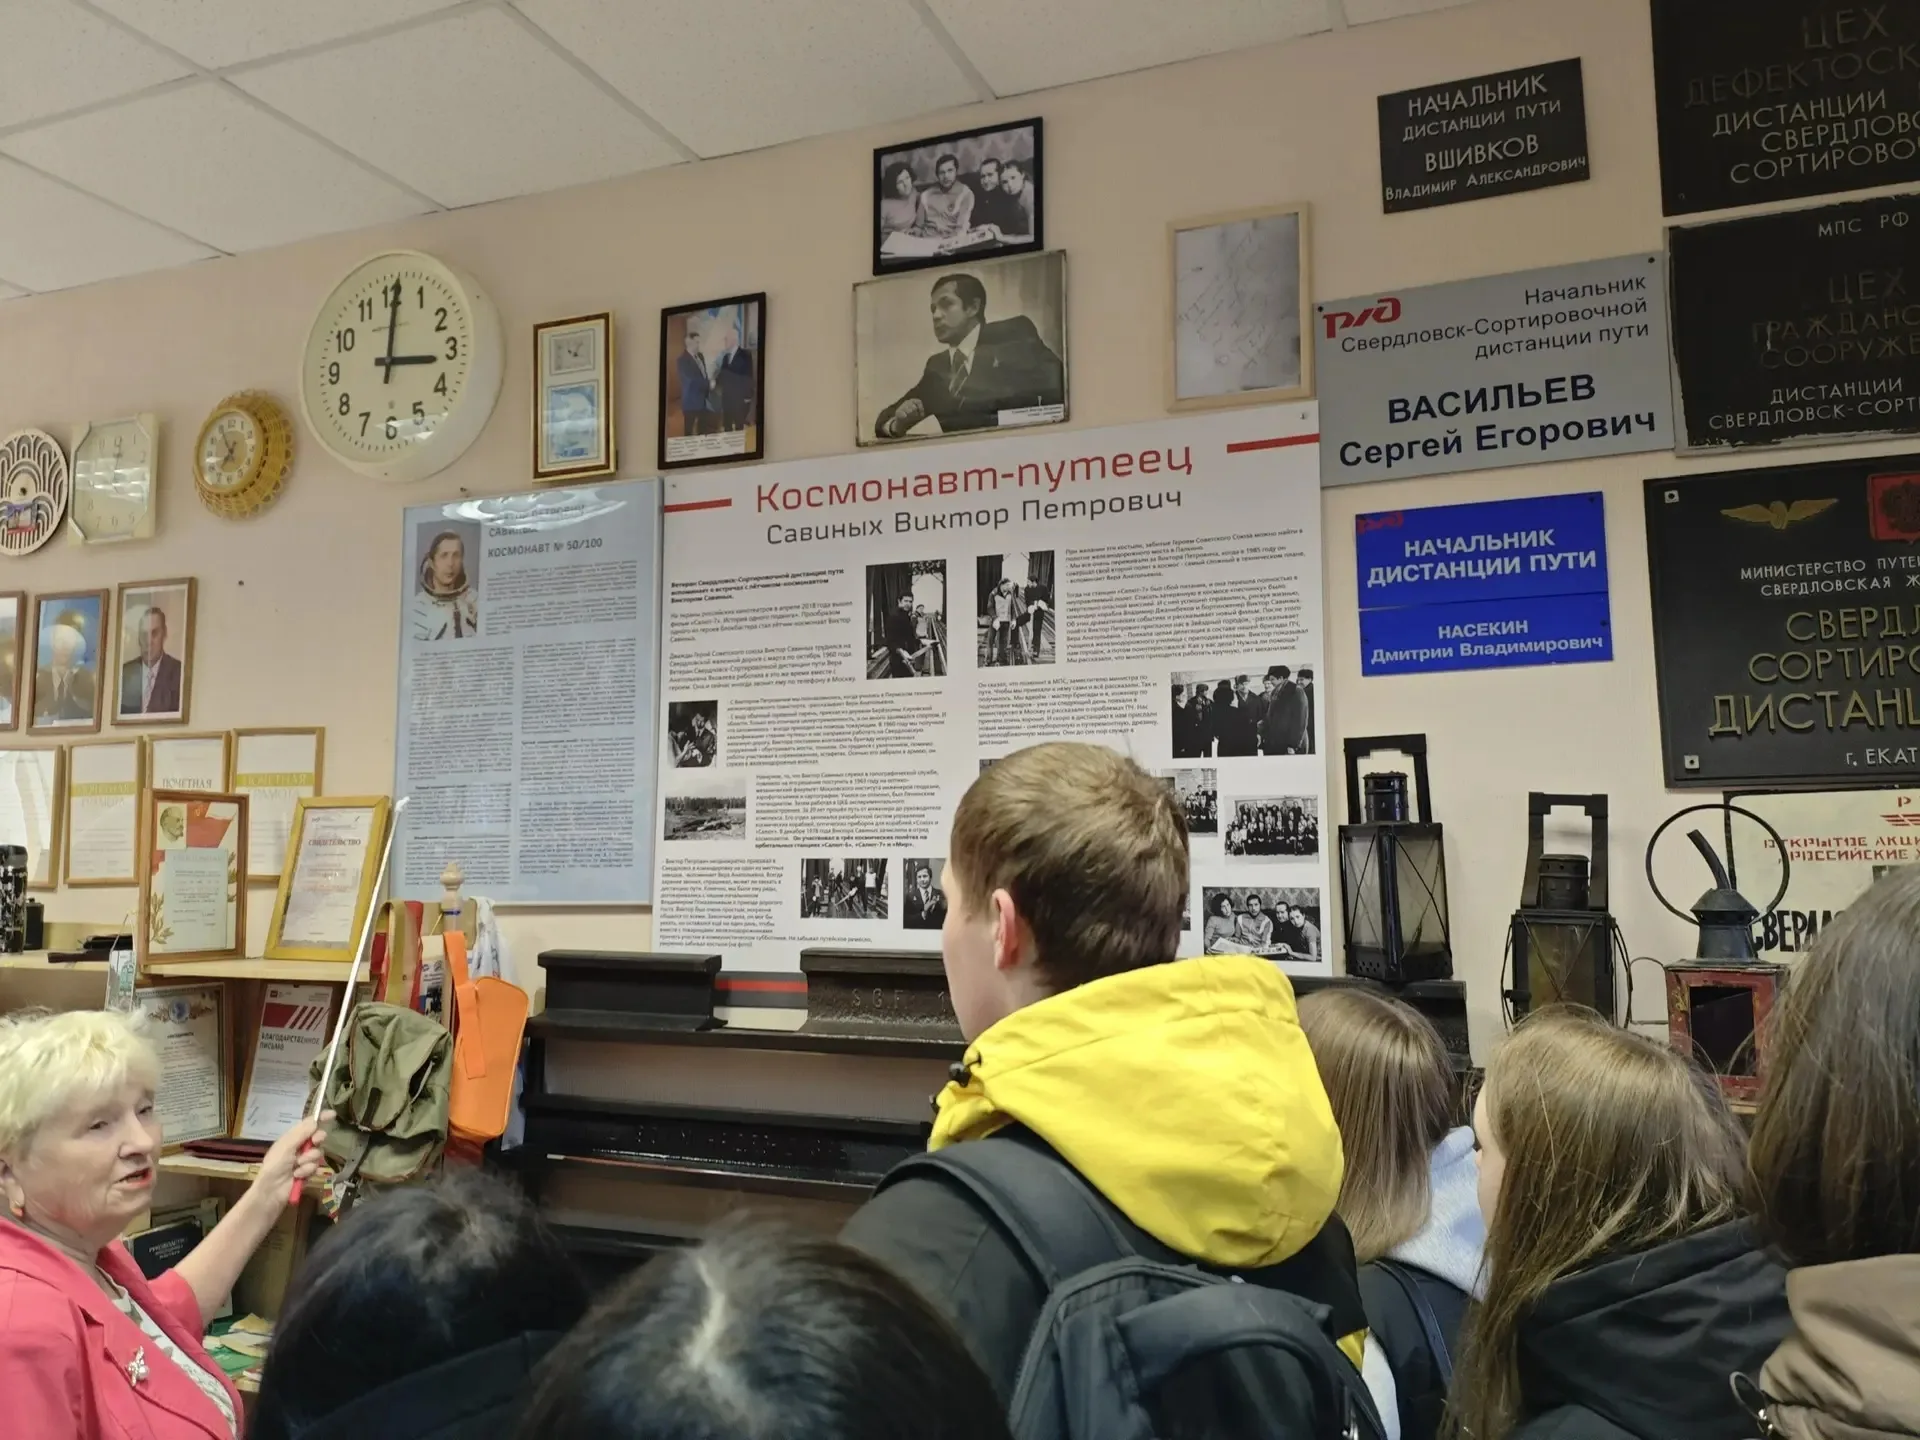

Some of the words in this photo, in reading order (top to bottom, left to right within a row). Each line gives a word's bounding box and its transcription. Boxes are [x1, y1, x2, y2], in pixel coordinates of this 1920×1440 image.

[1801, 4, 1890, 51] ЦЕХ
[1407, 74, 1548, 117] НАЧАЛЬНИК
[1712, 88, 1887, 139] ДИСТАНЦИИ
[1402, 112, 1506, 142] ДИСТАНЦИИ
[1515, 100, 1561, 121] ПУТИ
[1425, 134, 1540, 173] ВШИВКОВ
[1730, 136, 1920, 185] СОРТИРОВО
[1817, 217, 1863, 239] МПС
[1879, 211, 1909, 230] РФ
[358, 297, 373, 322] 11
[416, 286, 425, 309] 1
[1524, 275, 1646, 305] Начальник
[1828, 266, 1907, 305] ЦЕХ
[336, 328, 355, 353] 10
[434, 308, 448, 332] 2
[1341, 298, 1647, 354] Свердловск-Сортировочной
[1474, 330, 1593, 361] дистанции
[1598, 323, 1649, 348] пути
[328, 362, 340, 385] 9
[445, 336, 458, 360] 3
[338, 393, 350, 416] 8
[433, 372, 447, 396] 4
[1388, 373, 1597, 424] ВАСИЛЬЕВ
[1770, 376, 1904, 406] ДИСТАНЦИИ
[358, 412, 371, 437] 7
[385, 416, 398, 440] 6
[412, 401, 425, 425] 5
[1708, 397, 1920, 431] СВЕРДЛОВСК-СОРТ
[1339, 430, 1462, 473] Сергей
[1476, 411, 1656, 460] Егорович
[756, 443, 1194, 514] Космонавт-путеец
[767, 515, 883, 546] Савиных
[895, 504, 1010, 534] Виктор
[1021, 489, 1183, 526] Петрович
[487, 542, 550, 558] КОСМОНАВТ
[1404, 528, 1555, 558] НАЧАЛЬНИК
[1367, 556, 1521, 588] ДИСТАНЦИИ
[1530, 550, 1597, 573] ПУТИ
[1740, 558, 1867, 581] МИНИСТЕРСТВО
[1760, 575, 1892, 598] СВЕРДЛОВСКАЯ
[1438, 620, 1529, 640] НАСЕКИН
[1459, 636, 1603, 659] Владимирович
